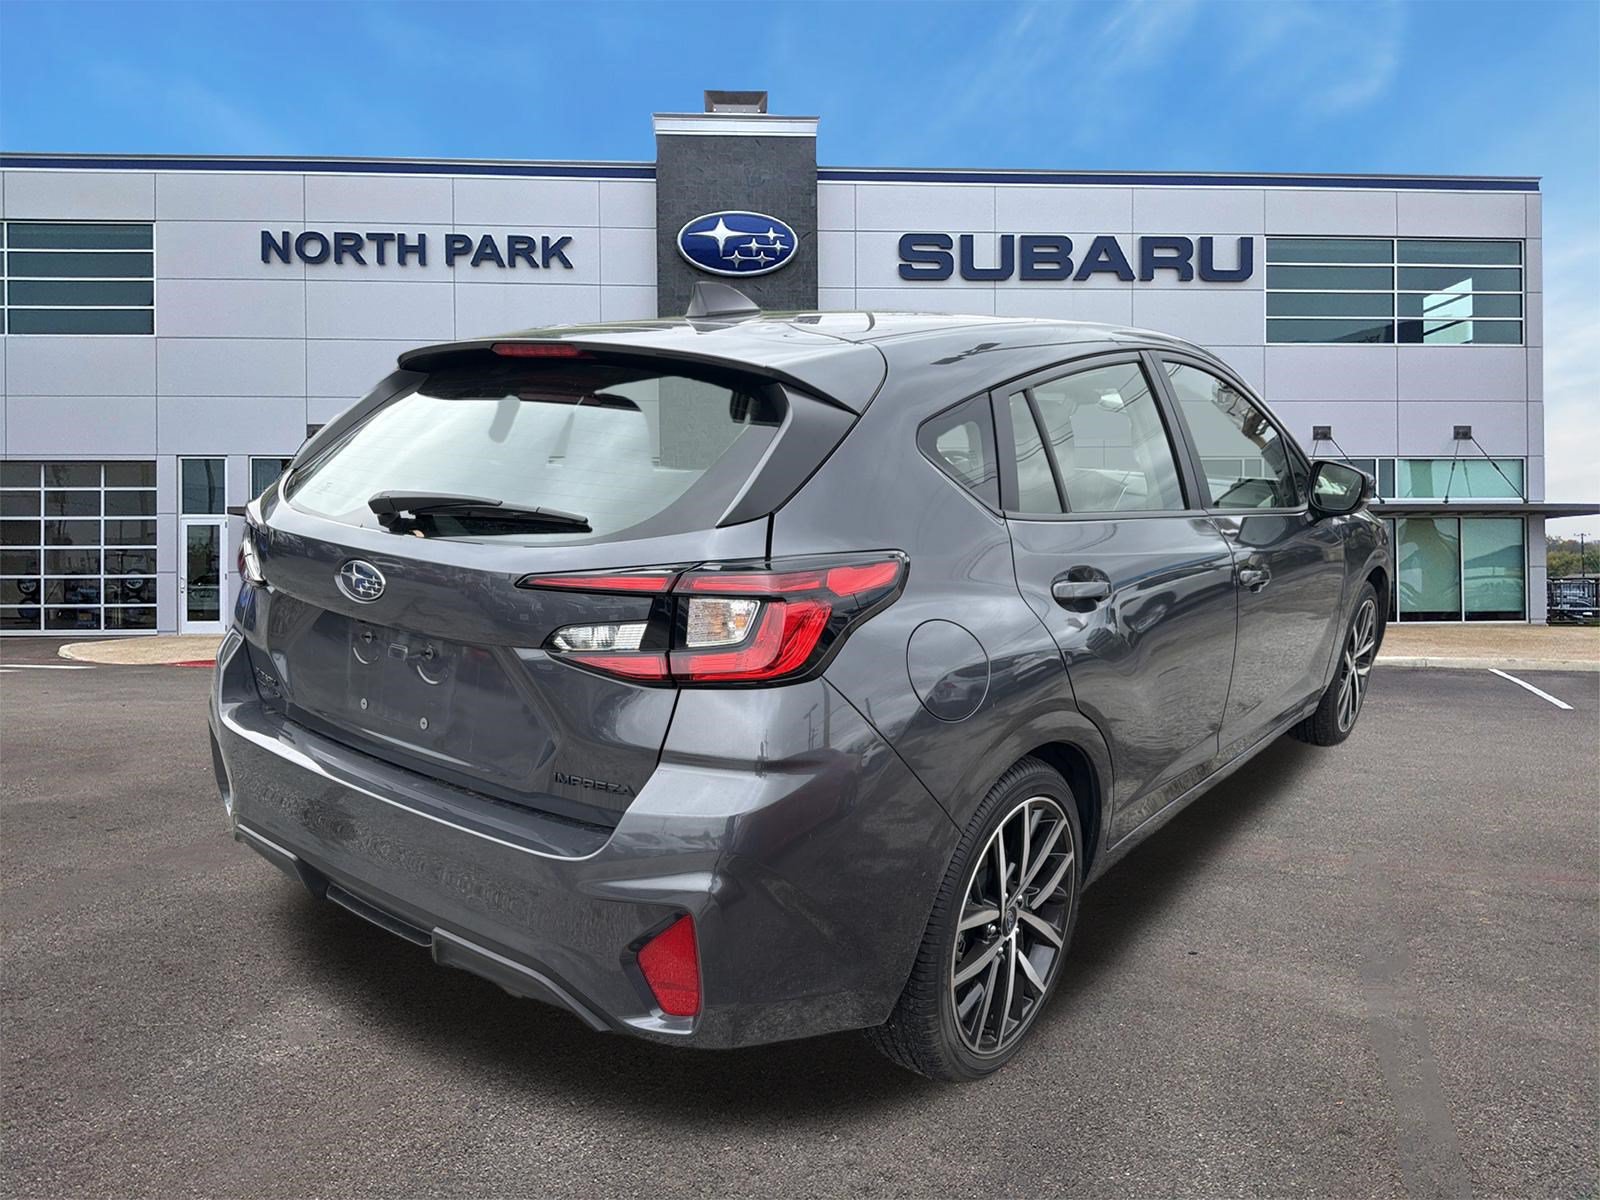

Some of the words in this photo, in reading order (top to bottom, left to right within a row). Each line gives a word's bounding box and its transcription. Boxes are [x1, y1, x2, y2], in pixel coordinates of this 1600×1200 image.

[260, 230, 427, 267] NORTH
[445, 233, 574, 269] PARK
[898, 232, 1254, 283] SUBARU
[553, 771, 637, 798] IMPREZA
